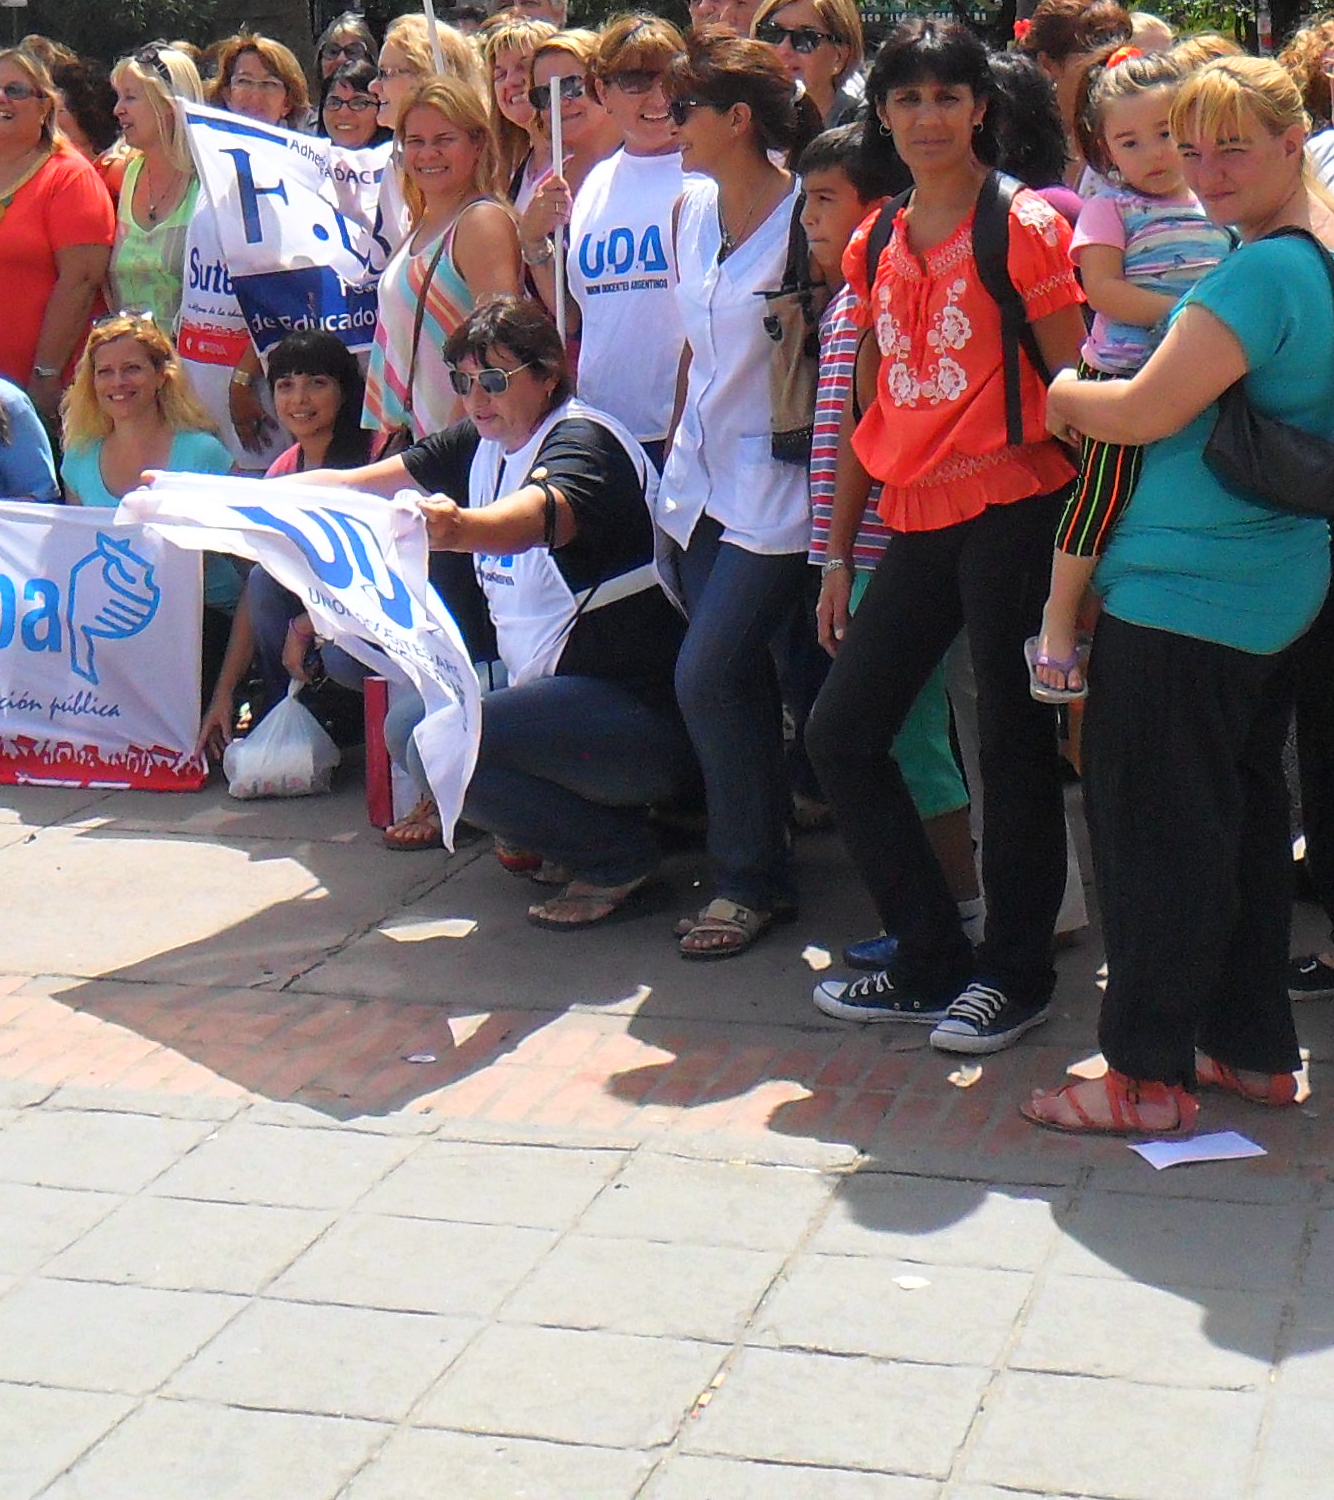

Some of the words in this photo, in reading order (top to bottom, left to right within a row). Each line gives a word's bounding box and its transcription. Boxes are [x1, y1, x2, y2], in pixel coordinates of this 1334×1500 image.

[335, 167, 372, 185] DAC
[277, 306, 378, 332] Educado
[47, 693, 122, 718] pública
